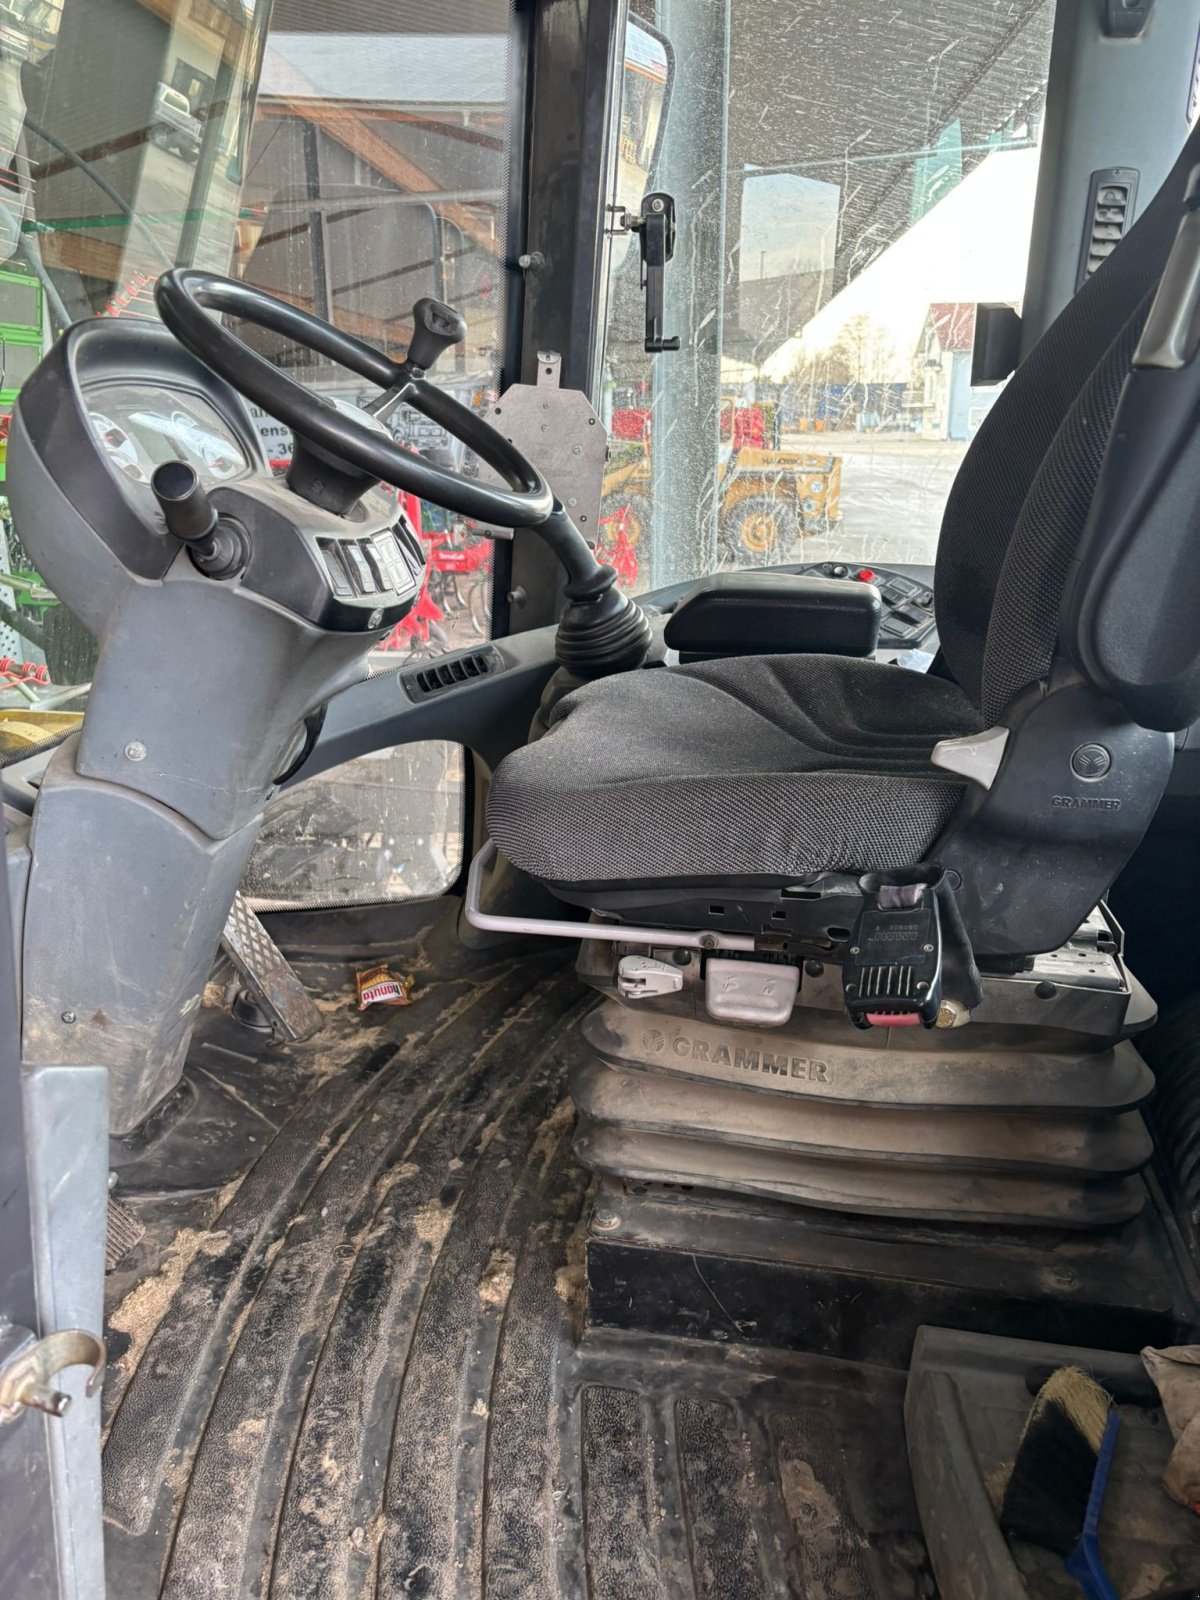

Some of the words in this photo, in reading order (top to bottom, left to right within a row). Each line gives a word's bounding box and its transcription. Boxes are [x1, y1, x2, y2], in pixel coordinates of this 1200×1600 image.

[1051, 795, 1121, 811] GRAMMER
[363, 984, 401, 1000] hanuta
[672, 1036, 829, 1083] GRAMMER
